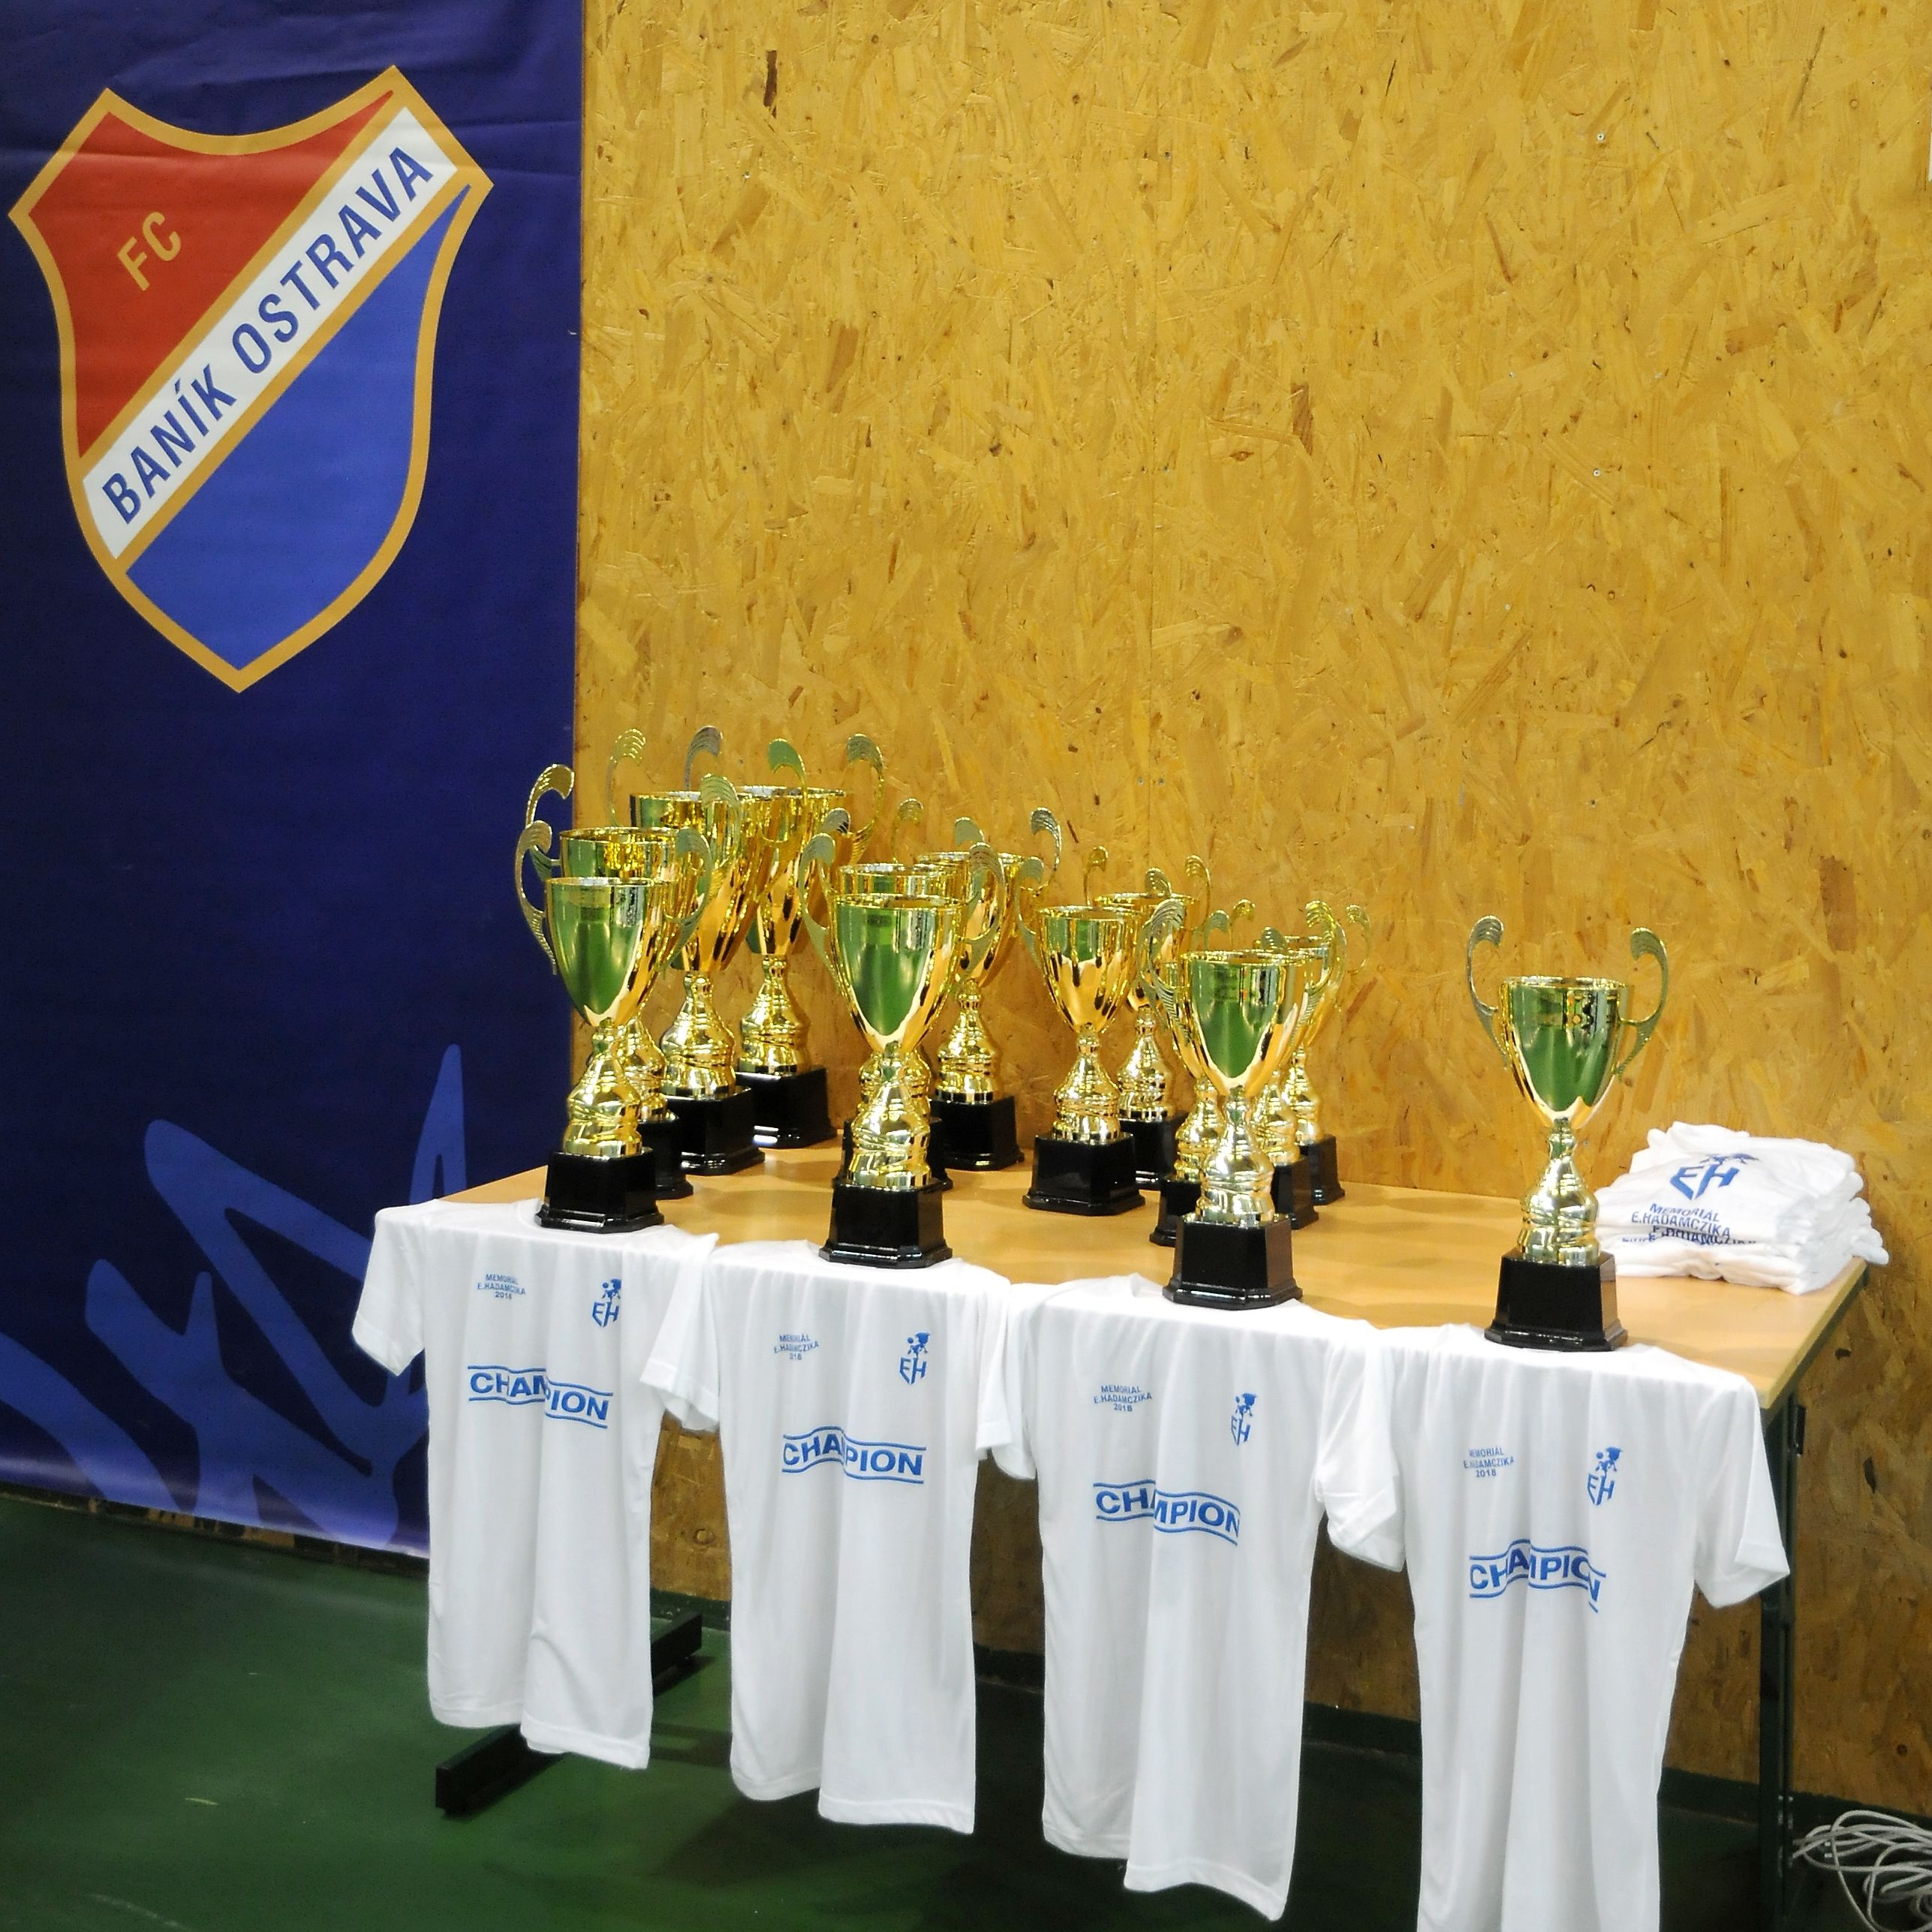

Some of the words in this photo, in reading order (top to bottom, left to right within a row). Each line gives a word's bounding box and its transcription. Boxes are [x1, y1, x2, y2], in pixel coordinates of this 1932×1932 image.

[117, 211, 182, 290] FC
[101, 364, 237, 524] BANÍK
[232, 146, 433, 374] OSTRAVA
[1632, 1211, 1731, 1238] E.HADAMCZIKA
[783, 1434, 922, 1476] CHAPION
[1476, 1469, 1497, 1477] 2018
